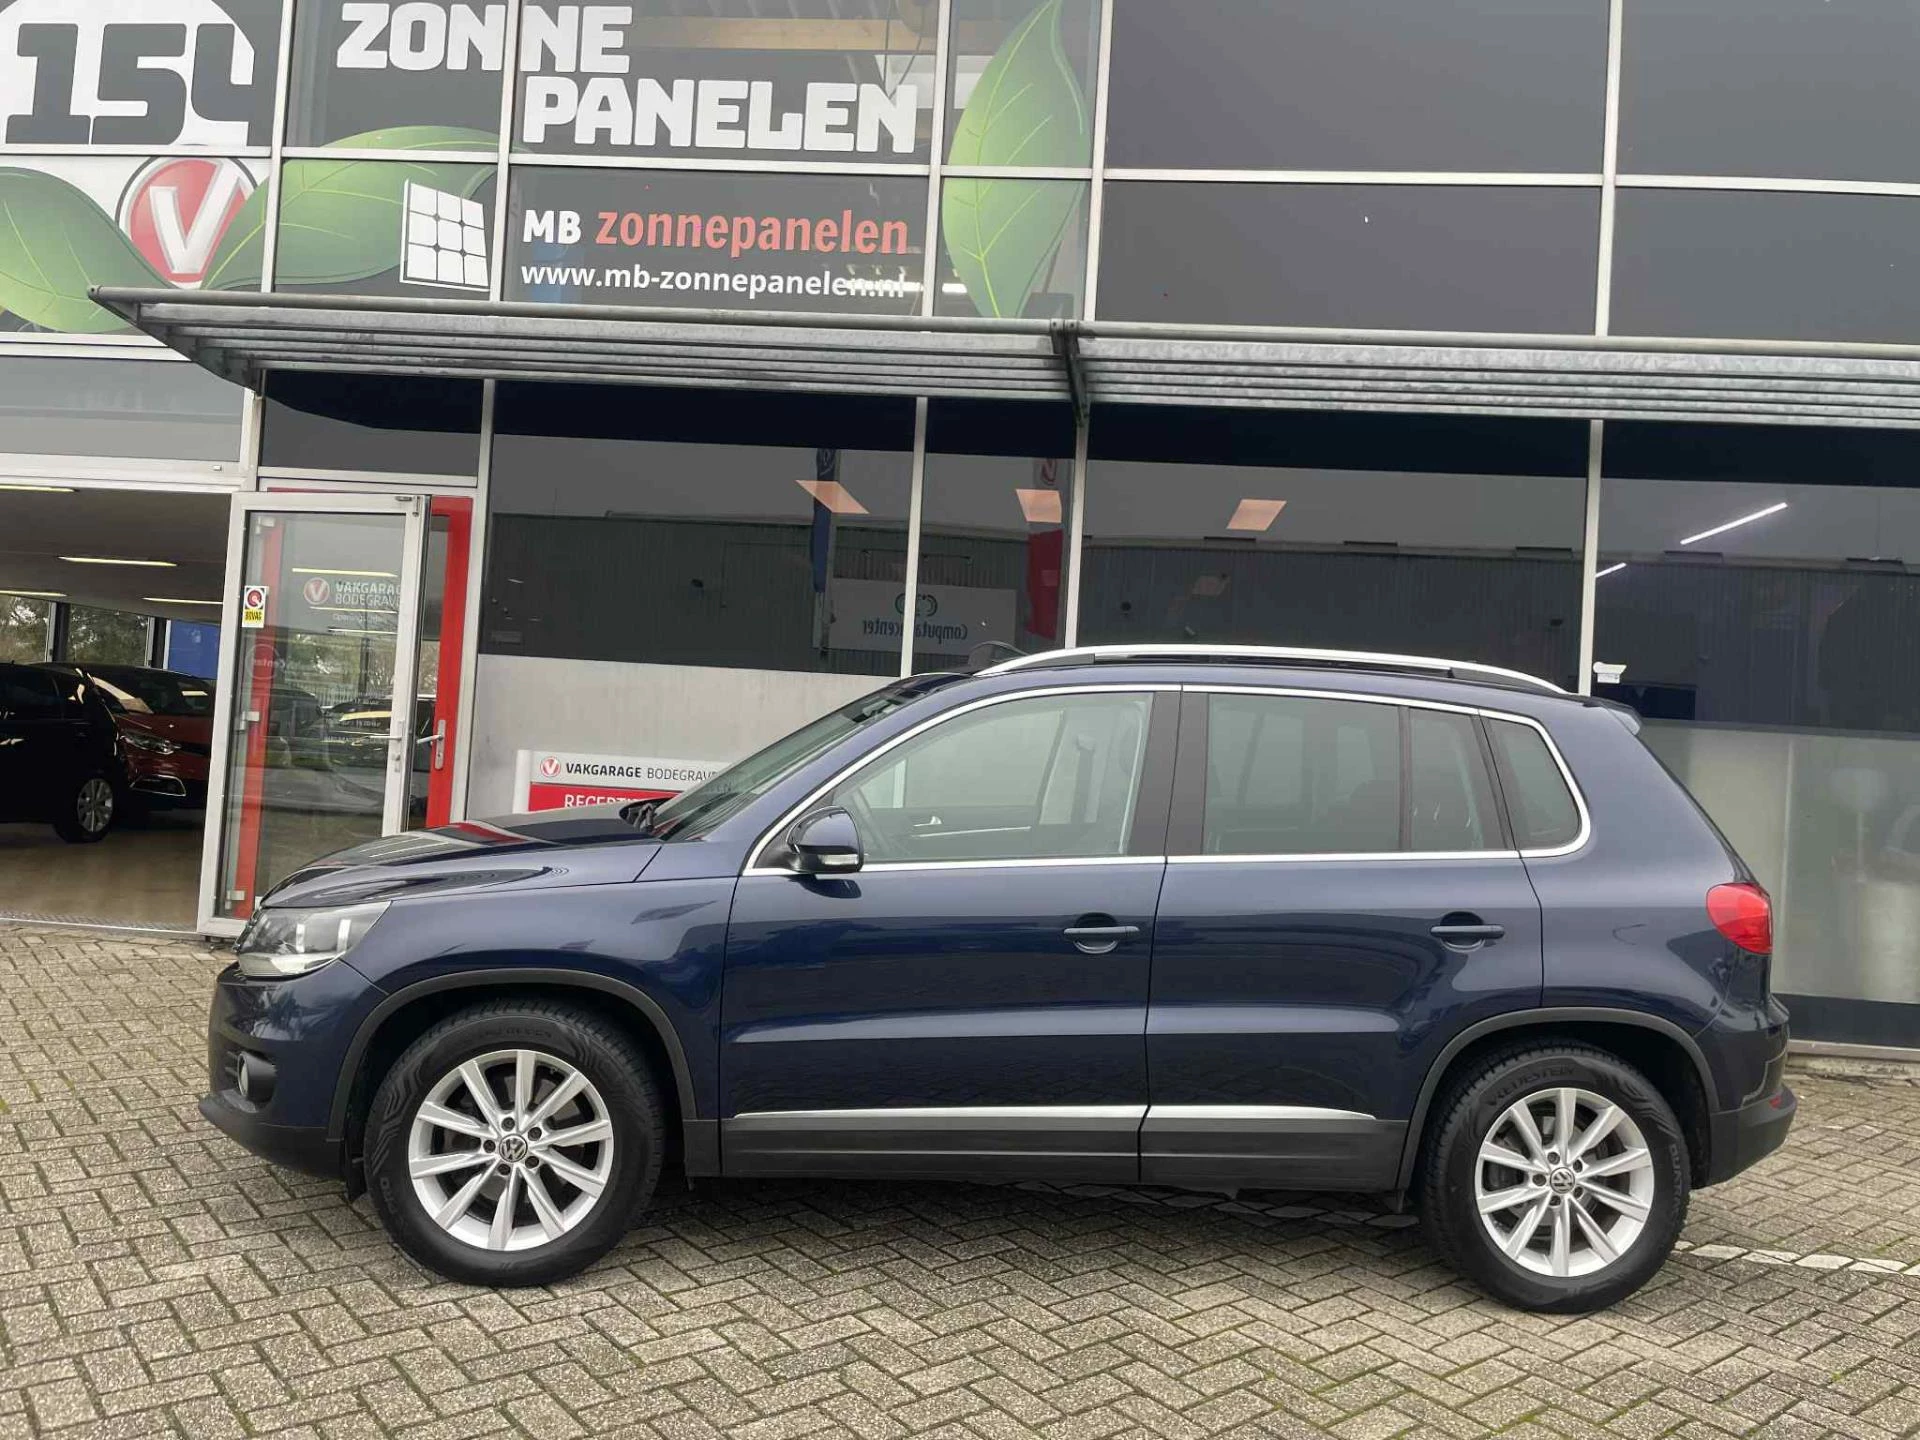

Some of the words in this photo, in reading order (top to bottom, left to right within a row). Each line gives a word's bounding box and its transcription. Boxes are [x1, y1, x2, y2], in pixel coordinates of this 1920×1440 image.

[336, 2, 633, 74] ZONNE
[5, 22, 256, 147] 154
[522, 76, 918, 154] PANELEN
[522, 209, 582, 245] MB
[594, 209, 909, 259] zonnepanelen
[520, 262, 905, 300] www.mb-zonnepanelen.nl
[566, 762, 642, 779] VAKGARAGE
